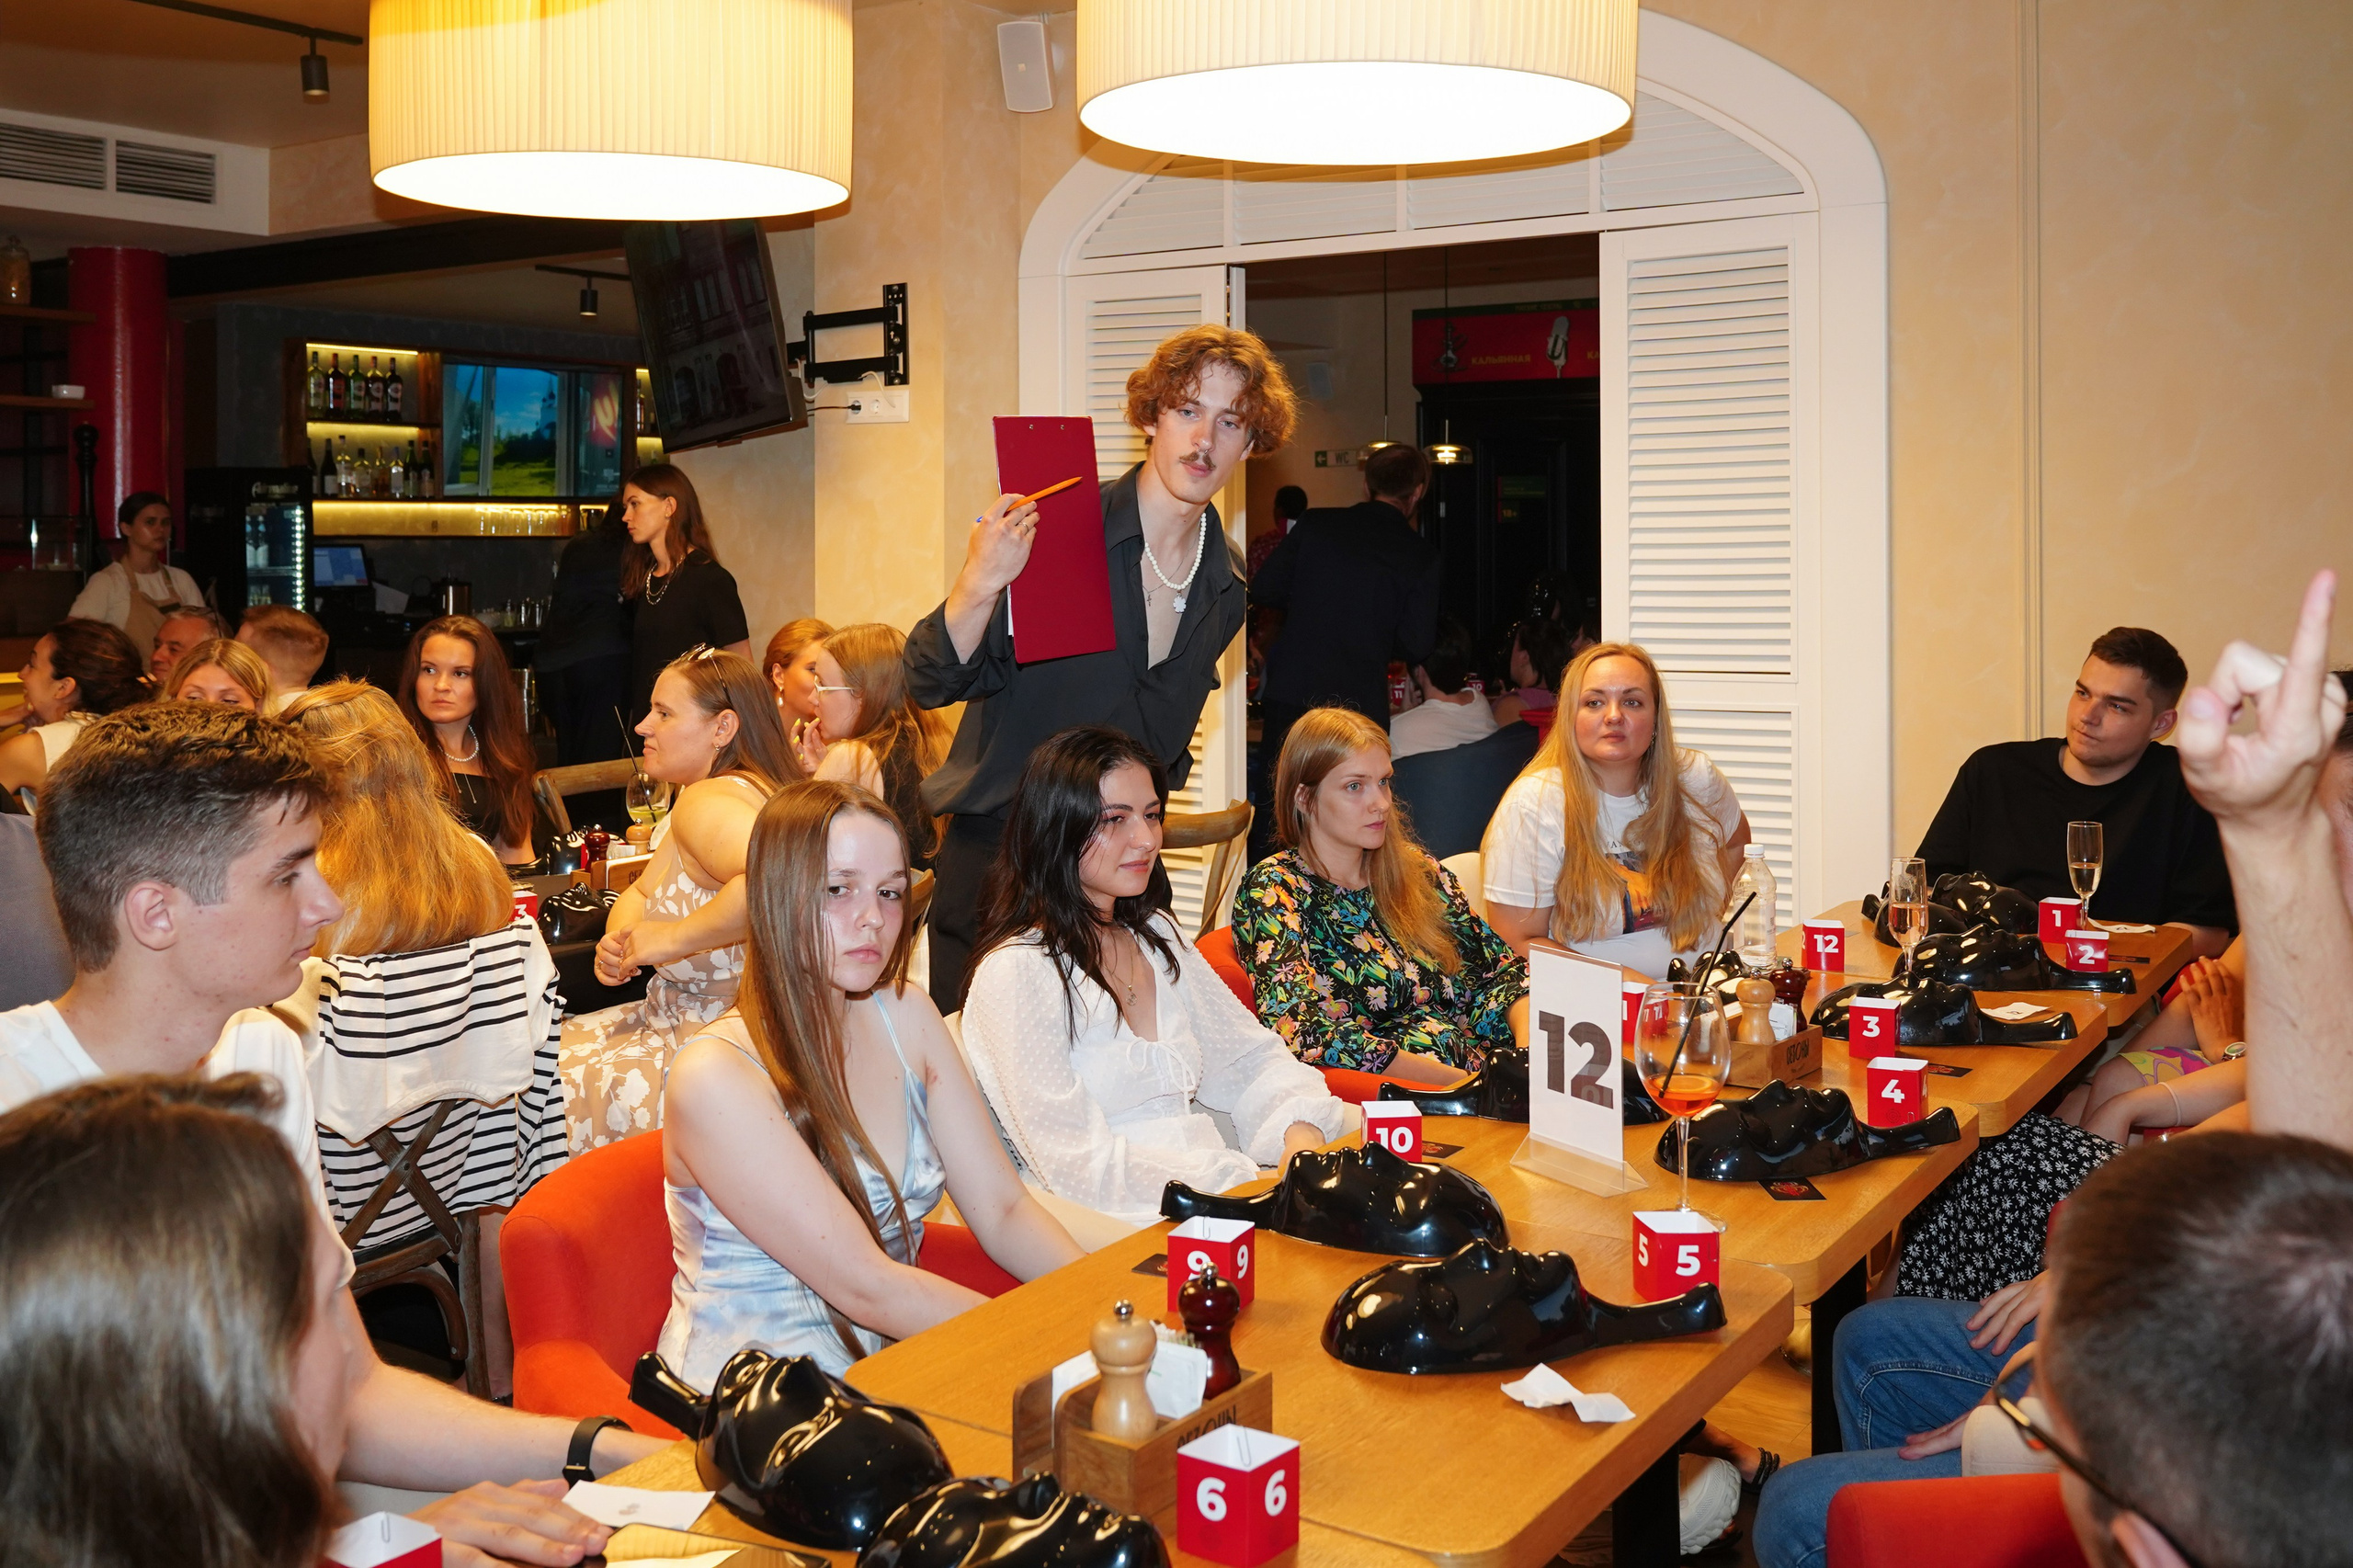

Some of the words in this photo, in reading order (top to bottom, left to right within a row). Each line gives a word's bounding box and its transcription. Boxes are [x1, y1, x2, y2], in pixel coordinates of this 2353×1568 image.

[1471, 353, 1531, 366] КАЛЬЯННАЯ
[1335, 451, 1349, 464] WC
[2052, 909, 2062, 927] 1
[1813, 934, 1839, 953] 12
[2078, 945, 2095, 965] 2
[1861, 1015, 1881, 1039] 3
[1538, 1010, 1614, 1109] 12
[1881, 1079, 1905, 1104] 4
[1375, 1126, 1414, 1153] 10
[1237, 1244, 1248, 1279] 9
[1638, 1233, 1649, 1267] 5
[1675, 1244, 1700, 1277] 5
[1197, 1477, 1227, 1521] 6
[1265, 1469, 1287, 1517] 6
